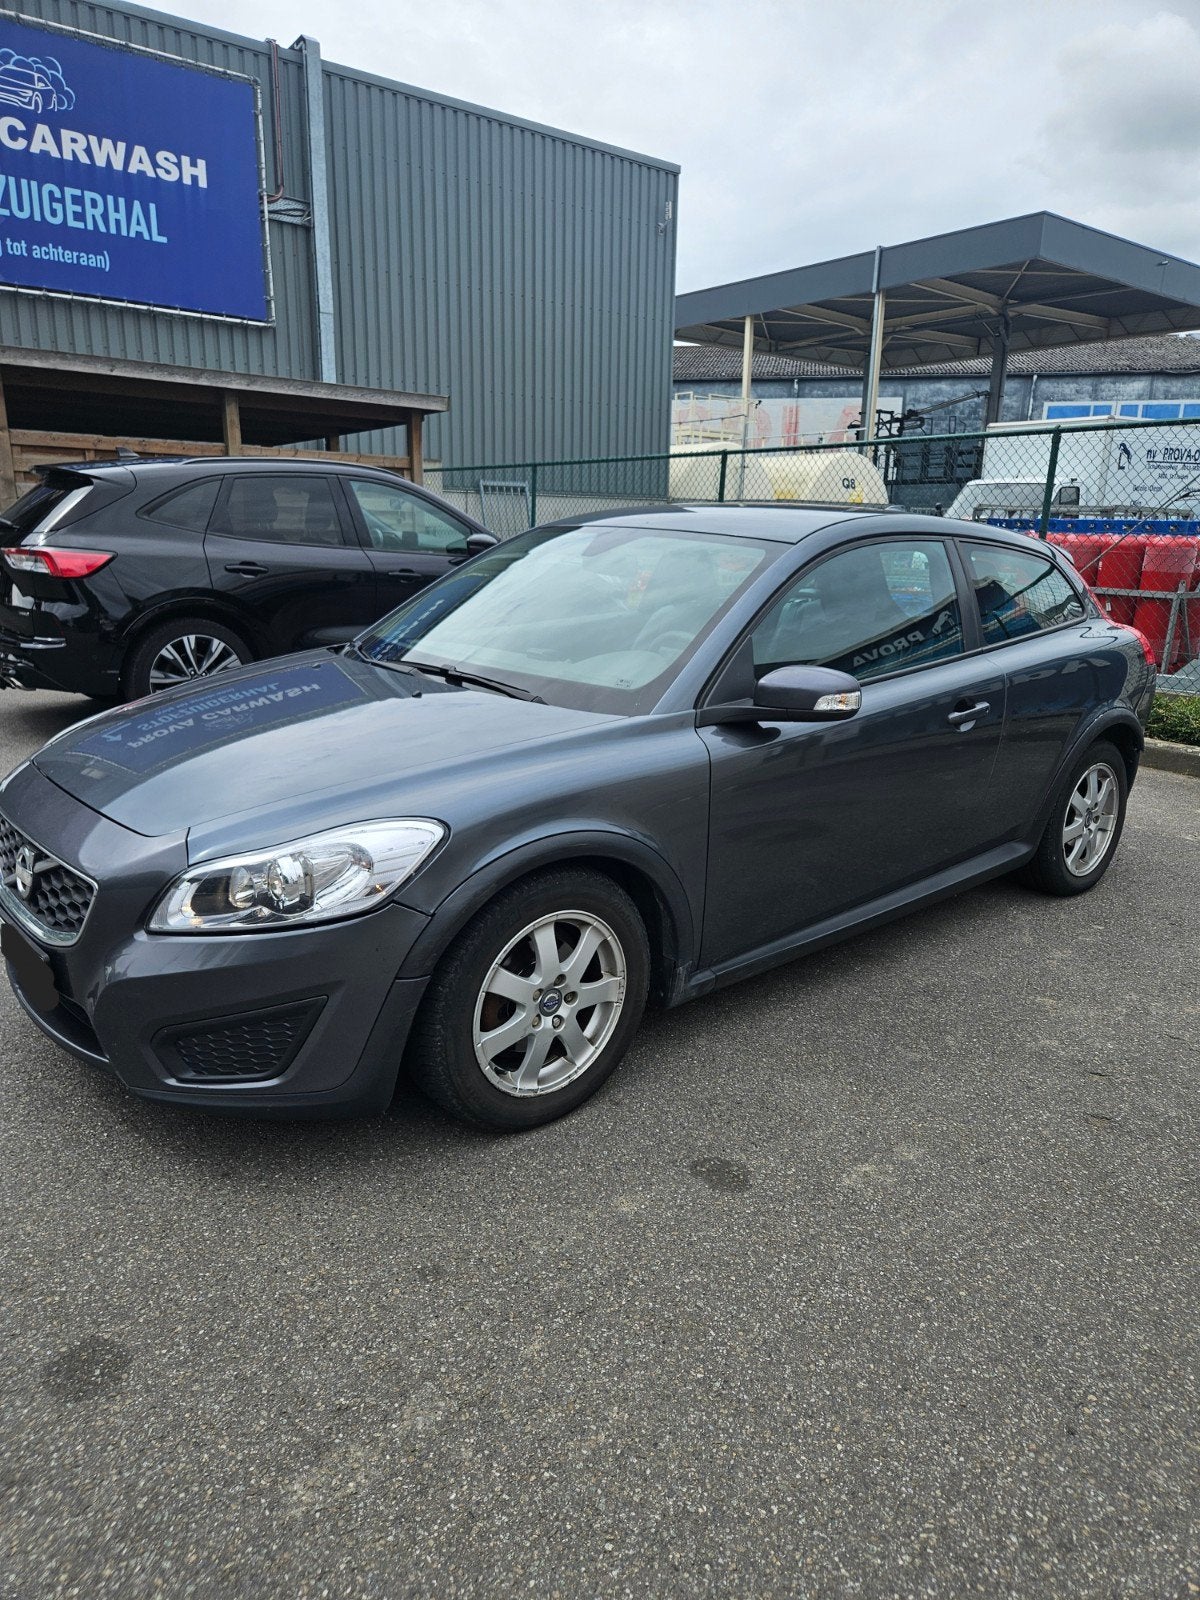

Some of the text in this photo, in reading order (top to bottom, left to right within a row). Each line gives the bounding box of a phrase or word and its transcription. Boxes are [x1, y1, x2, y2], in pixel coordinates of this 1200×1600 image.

[0, 117, 207, 188] CARWASH
[6, 237, 28, 257] tot
[32, 244, 110, 272] achteraan)
[842, 478, 855, 489] Q8
